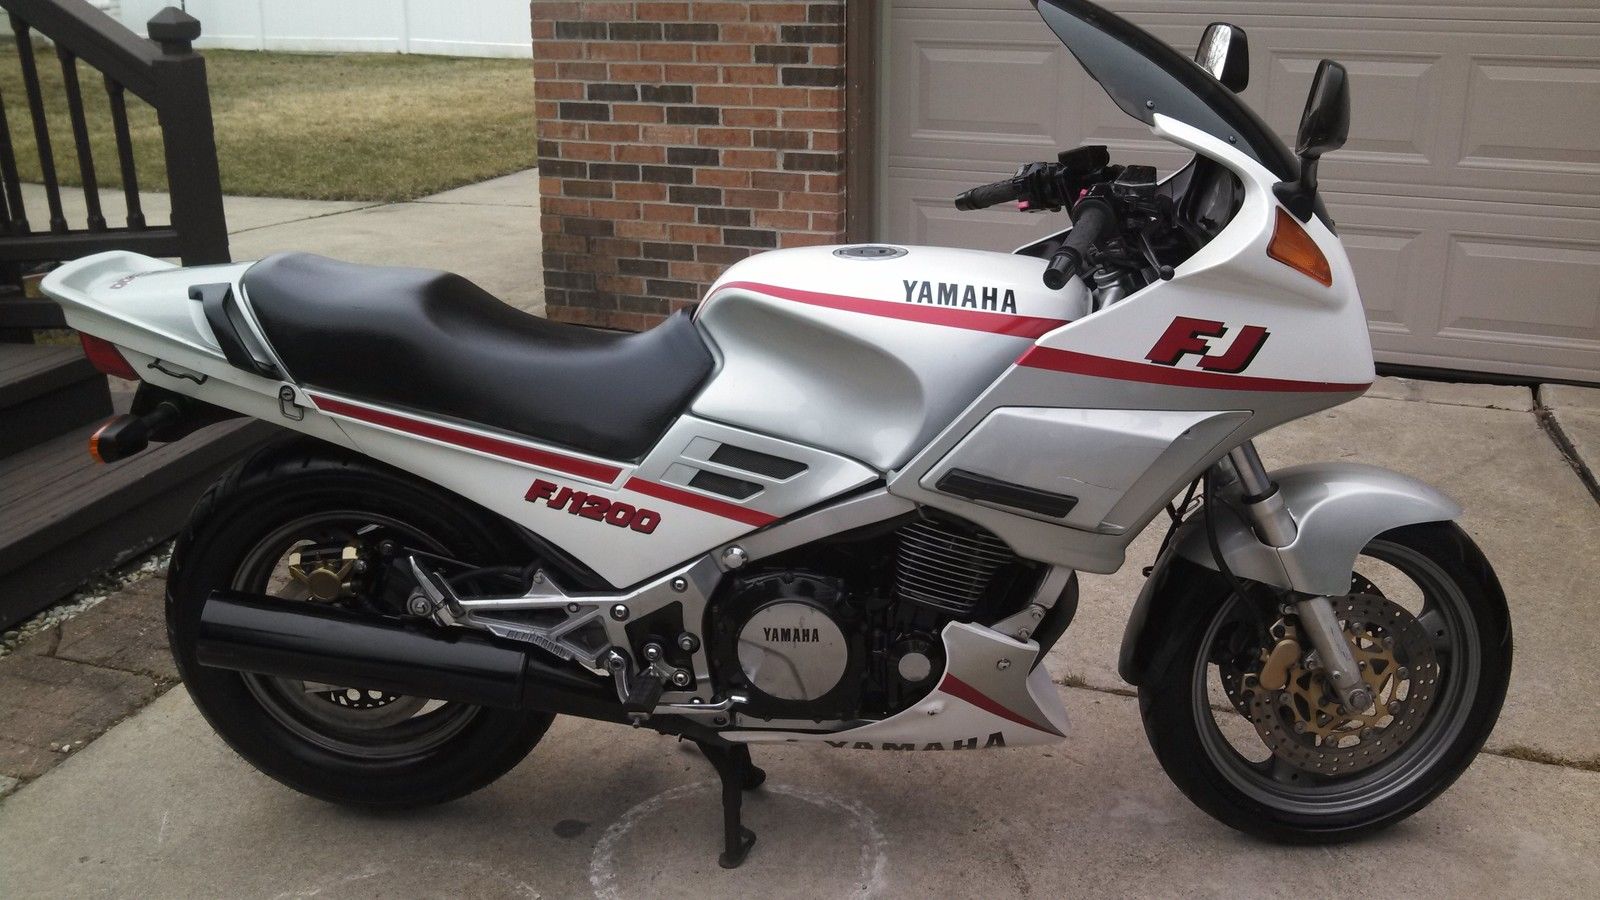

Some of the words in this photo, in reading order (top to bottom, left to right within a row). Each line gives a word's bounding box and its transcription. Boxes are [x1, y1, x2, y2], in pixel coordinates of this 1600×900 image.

[902, 279, 1017, 315] YAMAHA
[1144, 315, 1272, 374] FJ
[524, 478, 661, 535] FJ1200
[763, 627, 820, 643] YAMAHA
